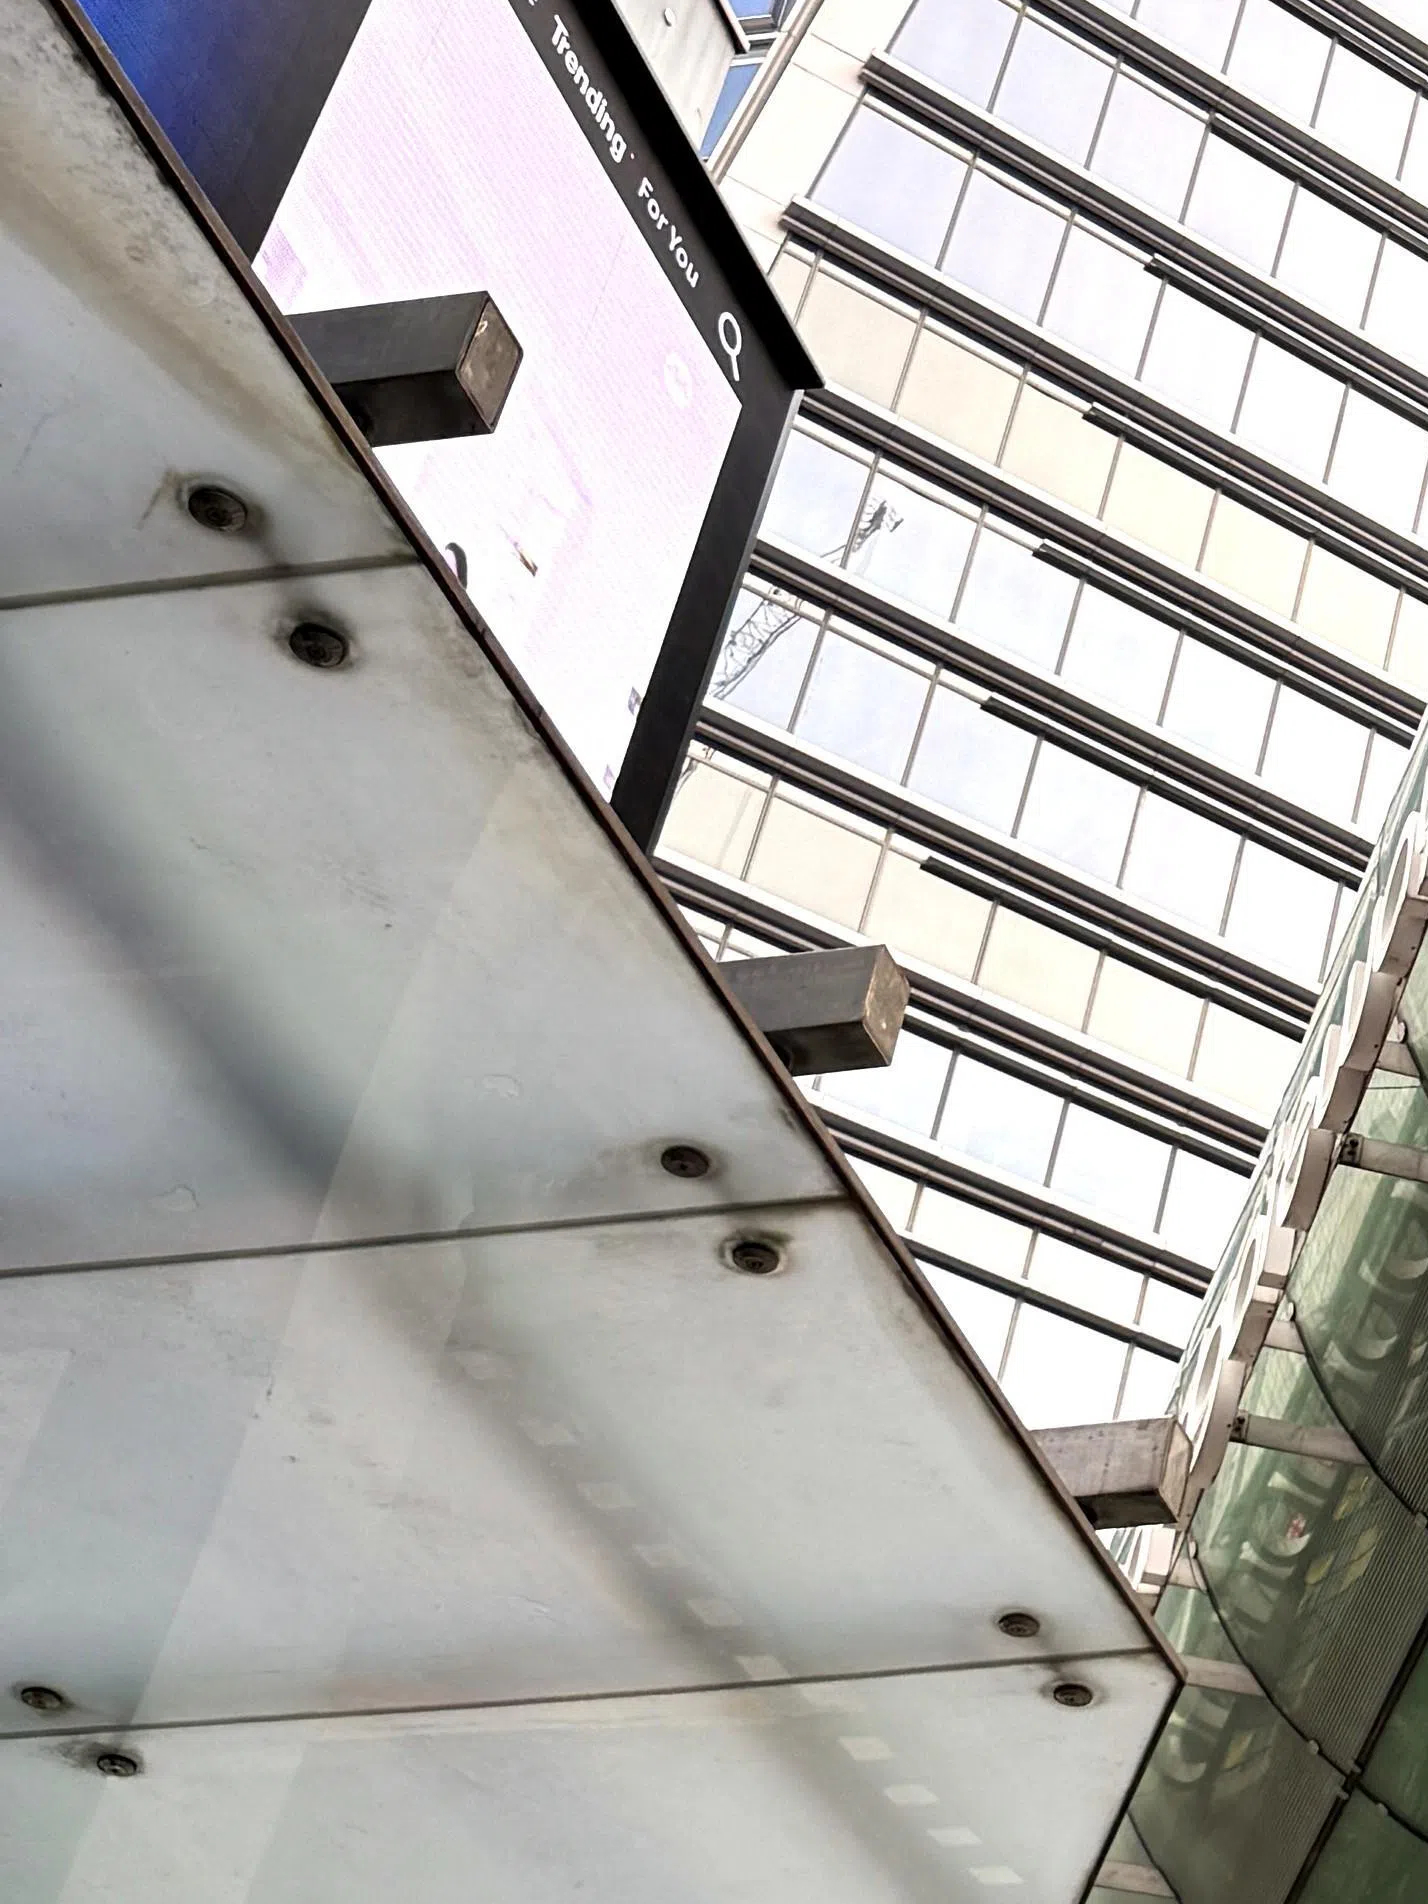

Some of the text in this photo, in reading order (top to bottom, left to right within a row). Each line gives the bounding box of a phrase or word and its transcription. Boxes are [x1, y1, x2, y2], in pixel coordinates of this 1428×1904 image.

[549, 14, 628, 164] Trending
[637, 177, 669, 231] For
[667, 224, 700, 289] You
